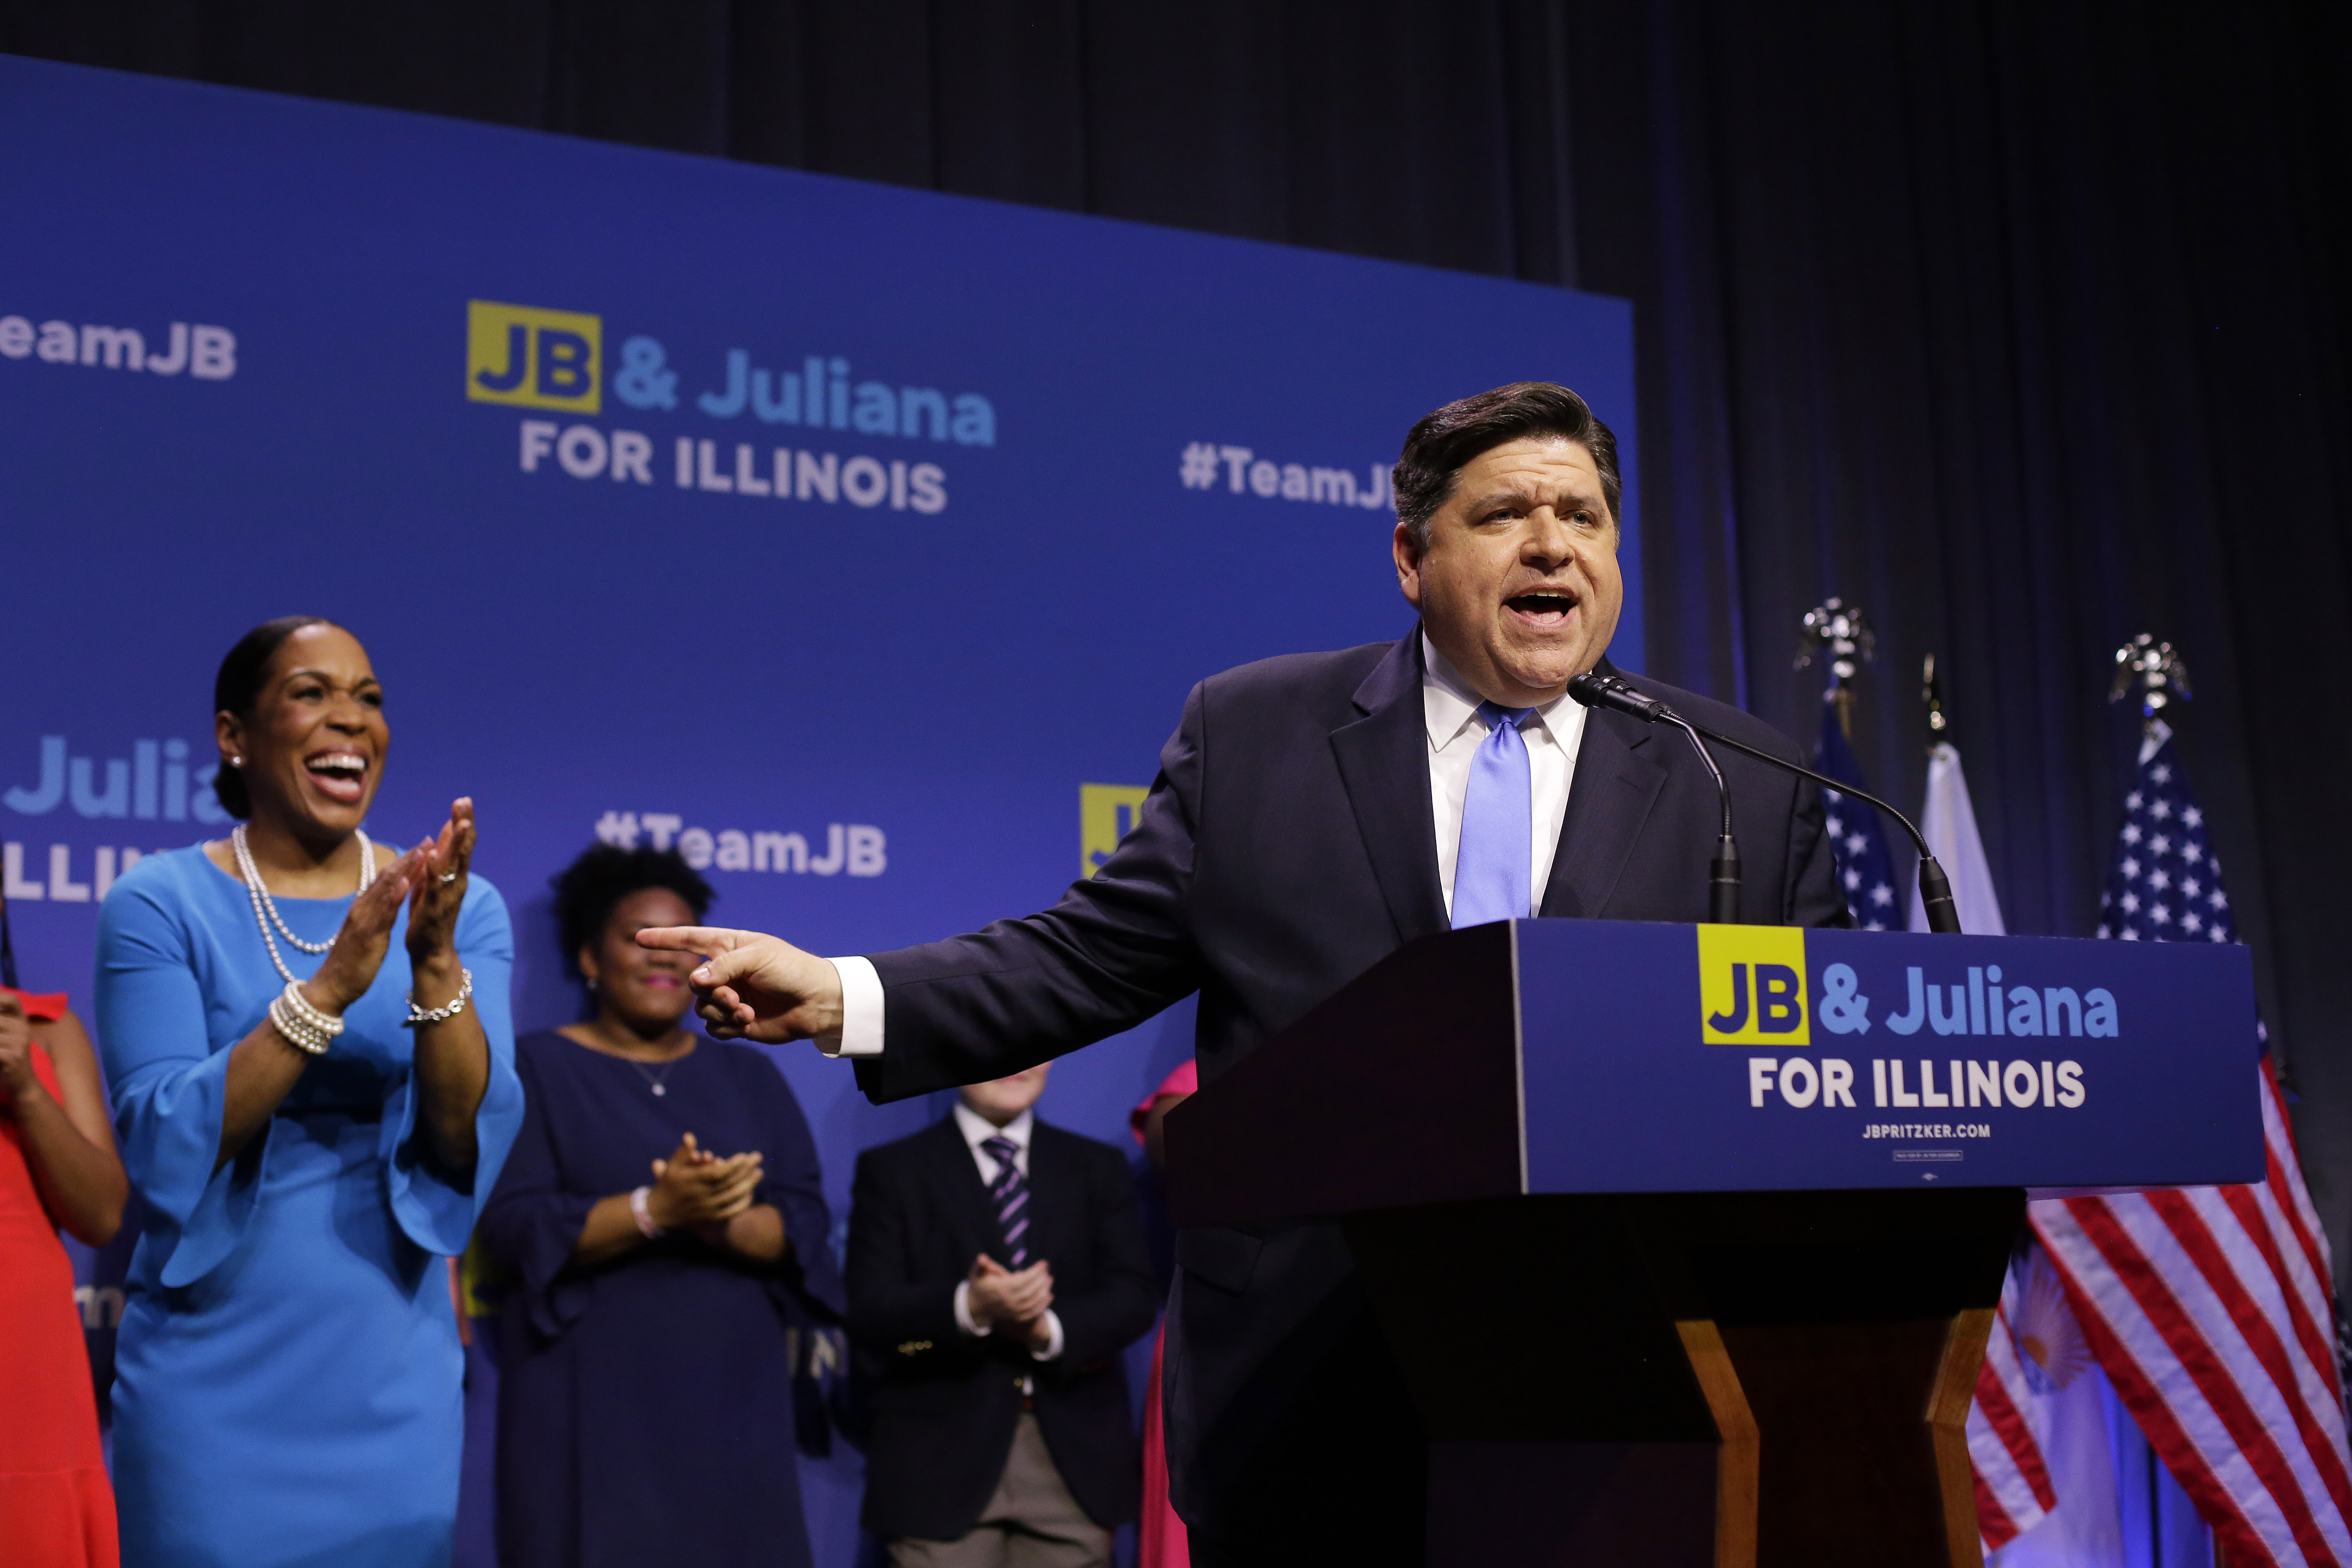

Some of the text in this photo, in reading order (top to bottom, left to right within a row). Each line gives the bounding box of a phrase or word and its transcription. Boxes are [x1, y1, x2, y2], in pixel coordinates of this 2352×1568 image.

[475, 323, 996, 446] JB & Juliana
[521, 421, 947, 514] FOR ILLINOIS
[1180, 441, 1398, 511] #TeamJ
[2, 841, 169, 902] LLI
[595, 811, 887, 877] #TeamJB
[1708, 962, 2119, 1038] JB & Juliana
[1748, 1058, 2086, 1108] FOR ILLINOIS
[1862, 1124, 1991, 1138] JBPRITZKER.COM
